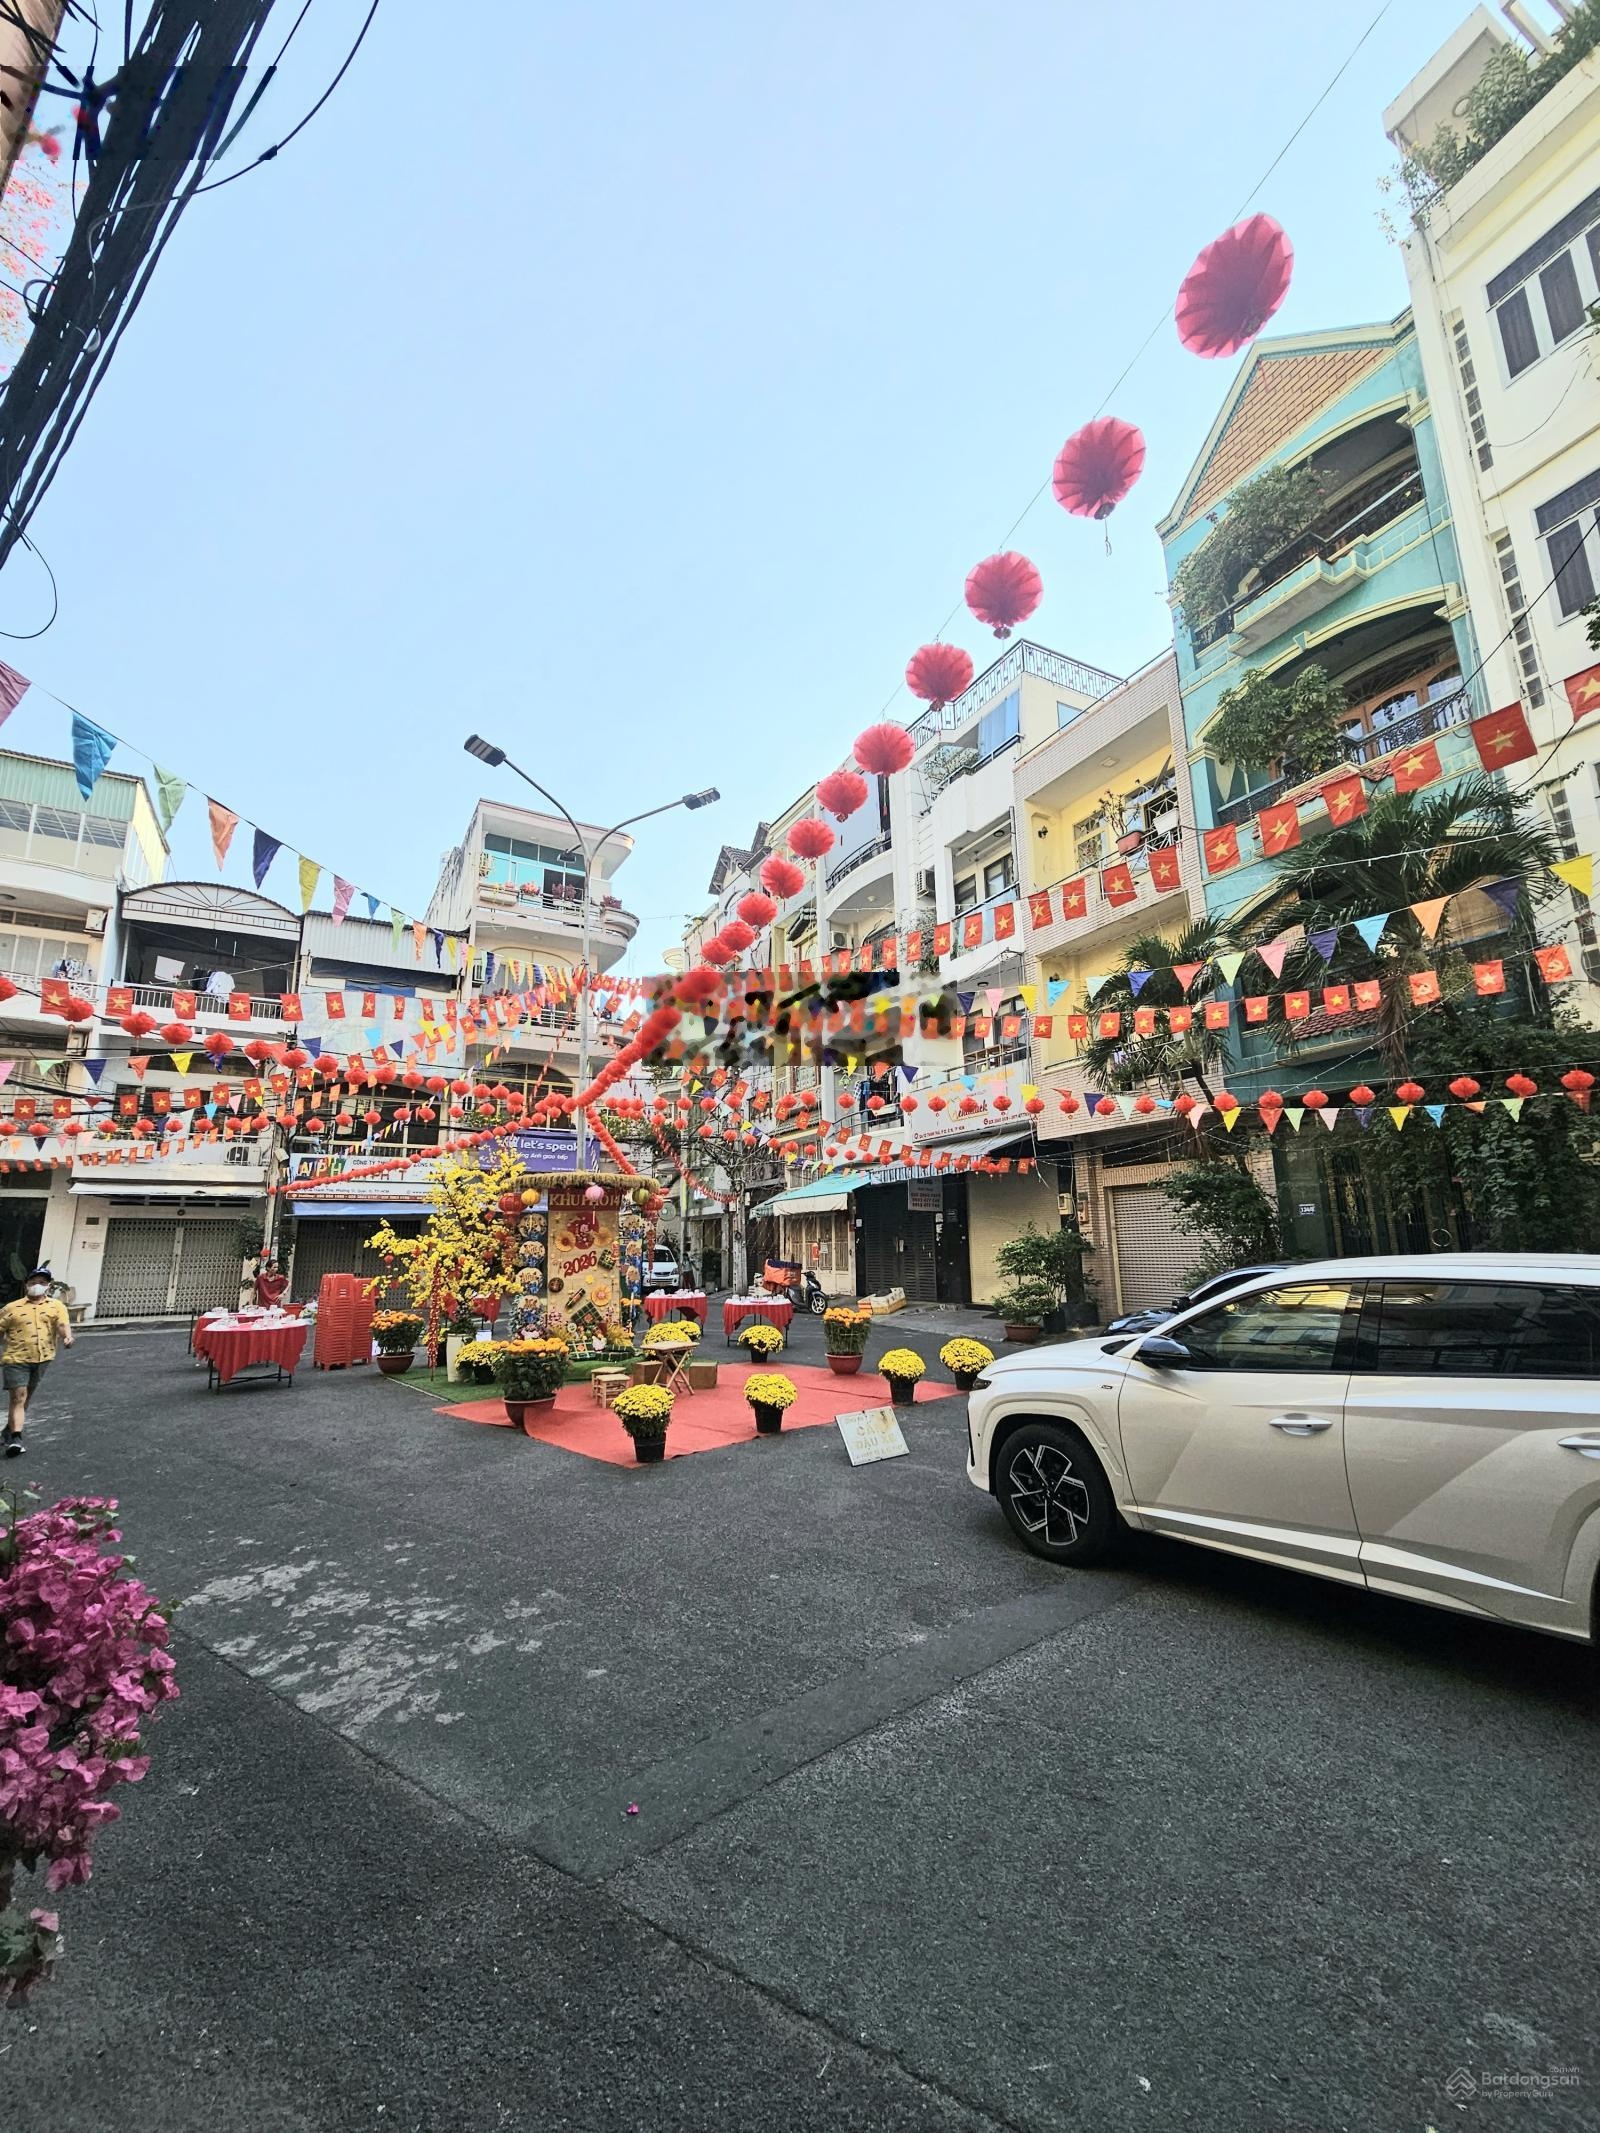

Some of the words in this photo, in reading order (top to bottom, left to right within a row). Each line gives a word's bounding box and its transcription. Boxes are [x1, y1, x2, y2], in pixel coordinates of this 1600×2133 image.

[520, 1139, 545, 1150] let's
[549, 1193, 580, 1206] KHU
[563, 1250, 598, 1278] 2026
